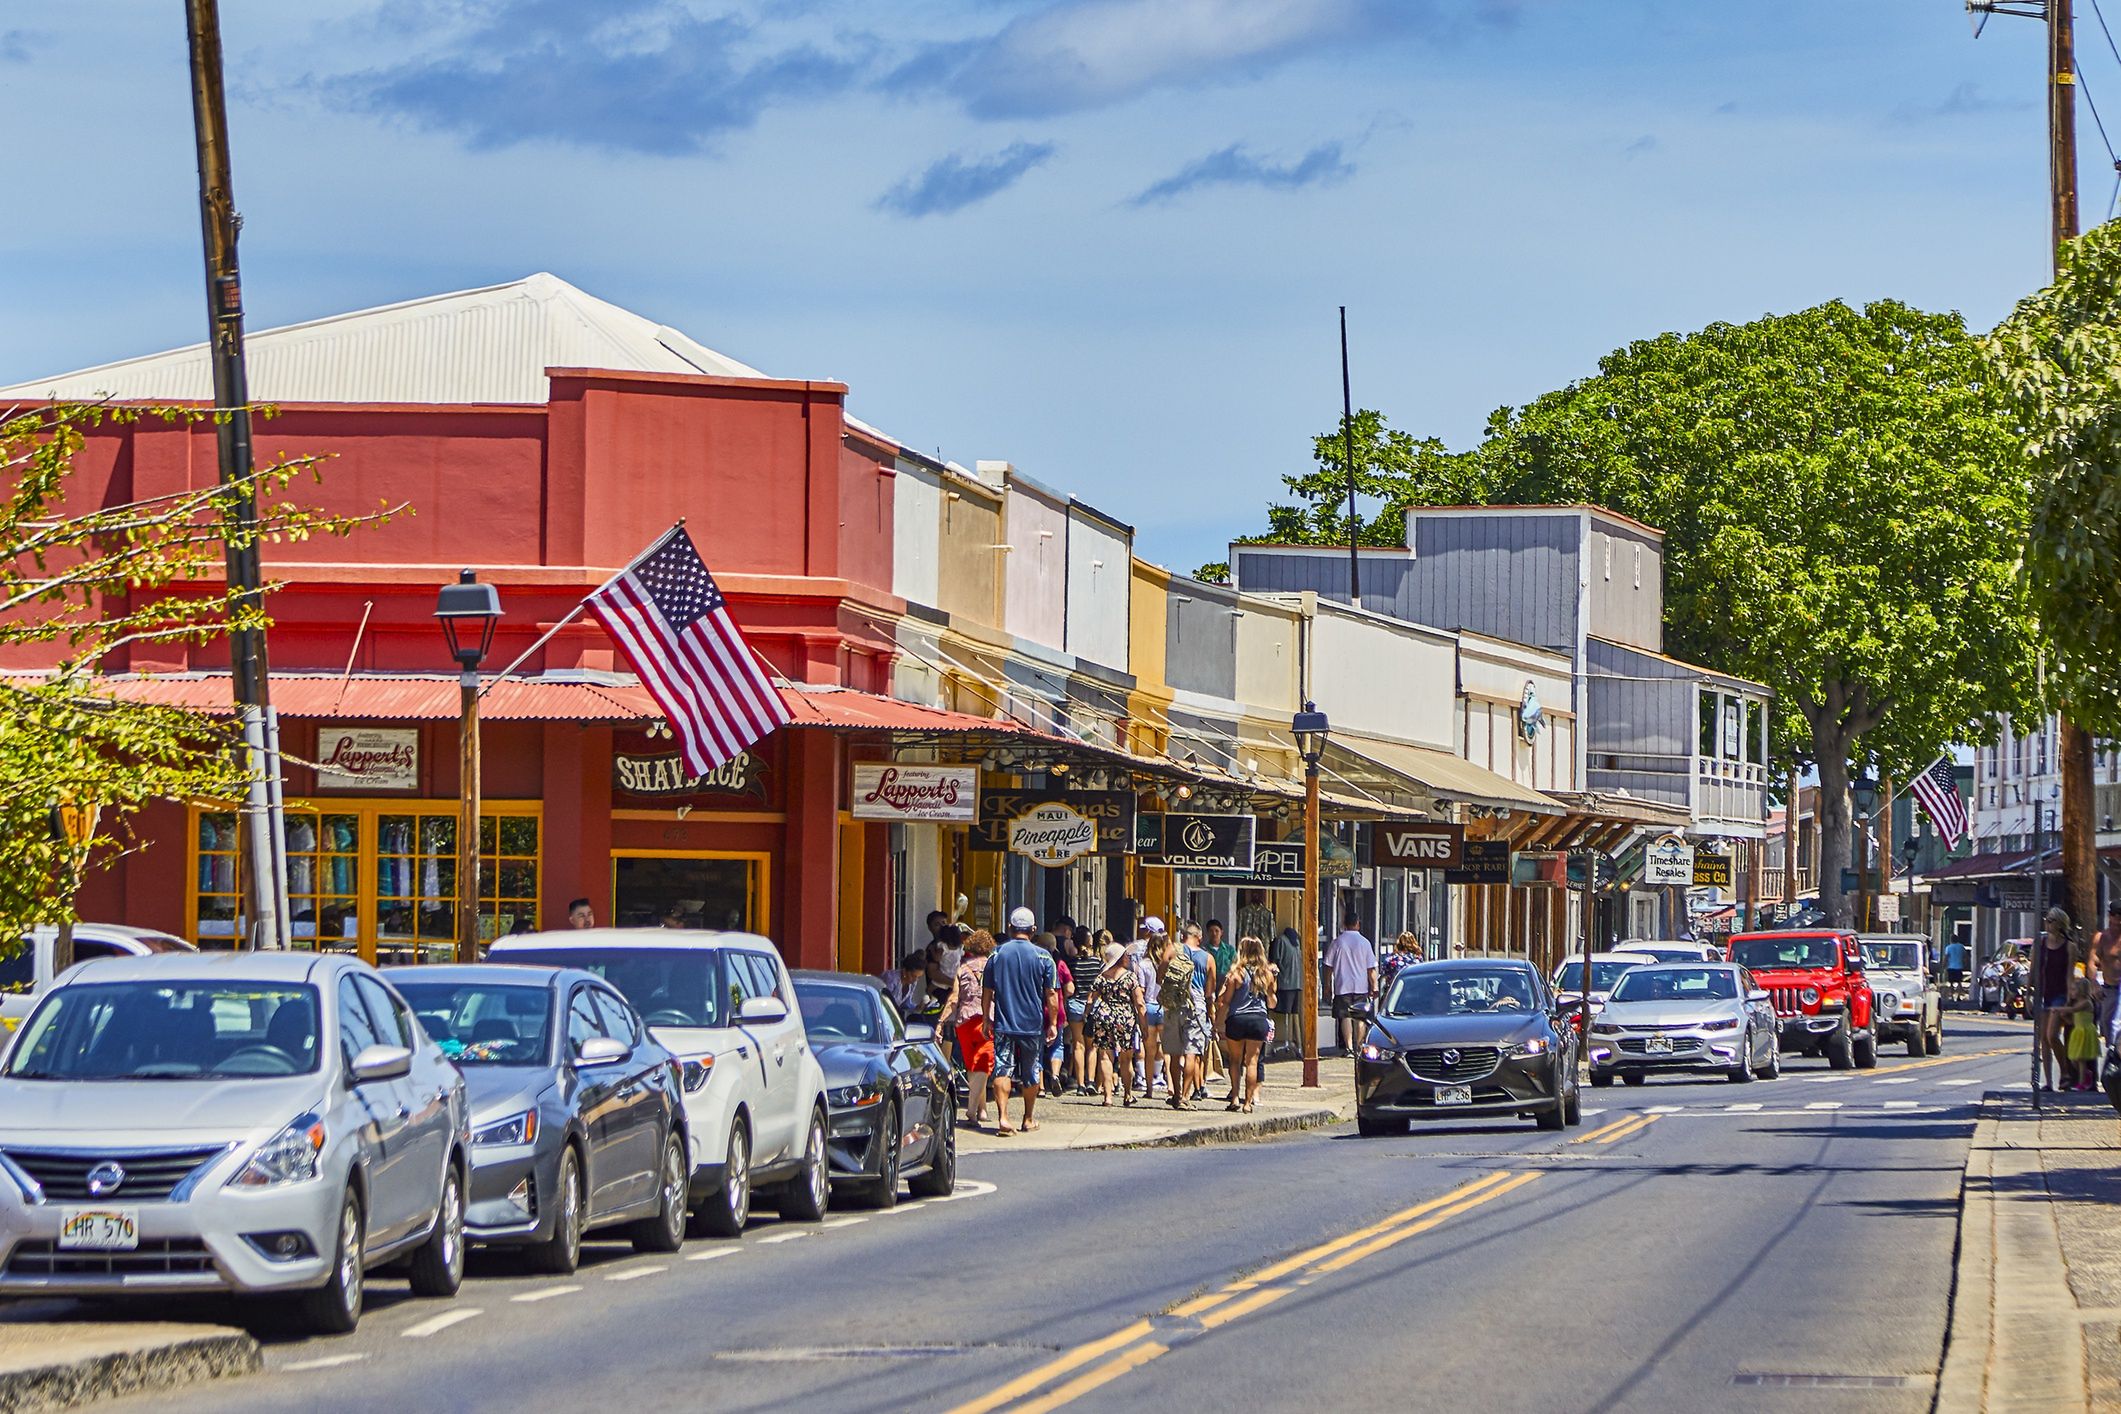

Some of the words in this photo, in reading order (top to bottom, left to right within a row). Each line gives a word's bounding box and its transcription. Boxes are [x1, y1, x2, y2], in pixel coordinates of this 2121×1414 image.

[1037, 812, 1068, 820] MAUI
[1013, 821, 1091, 847] Pineapple
[1136, 837, 1158, 847] ear
[1386, 832, 1451, 859] VANS
[1034, 850, 1070, 858] STRE
[1163, 855, 1235, 867] VOLCOM
[1254, 850, 1305, 873] APEL
[1649, 855, 1691, 866] Timeshare
[1655, 867, 1686, 878] Resales
[1694, 873, 1711, 883] ass
[1713, 873, 1729, 883] Co.
[64, 1217, 94, 1238] LHR
[103, 1218, 134, 1238] 570
